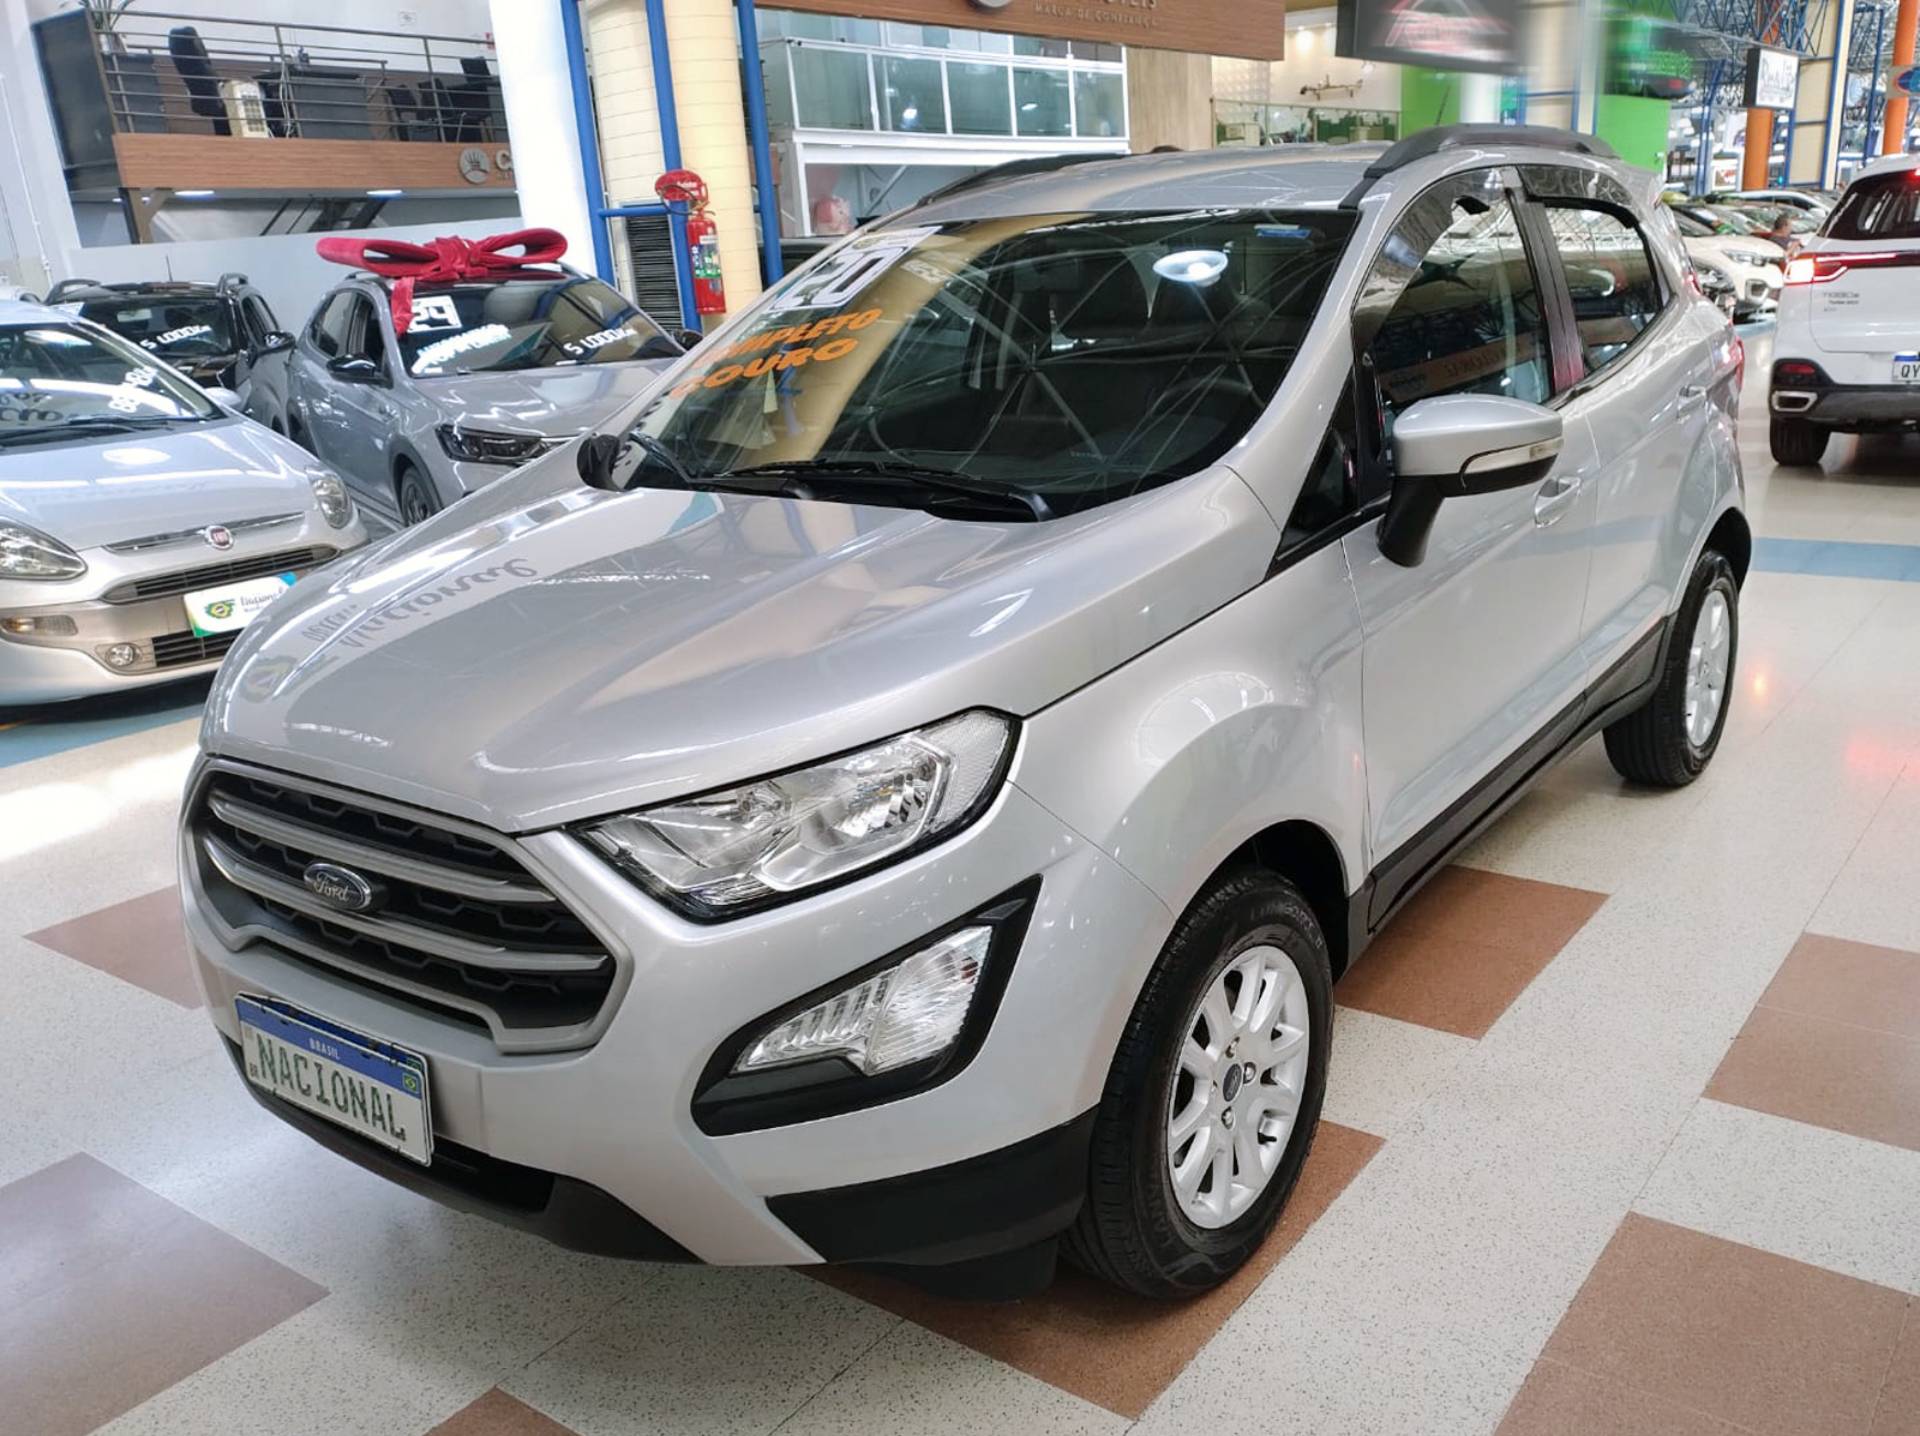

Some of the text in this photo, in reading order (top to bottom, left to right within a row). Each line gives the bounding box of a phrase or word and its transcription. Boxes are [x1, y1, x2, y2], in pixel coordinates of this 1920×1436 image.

[312, 870, 351, 903] Ford
[309, 1037, 341, 1060] BRASIL
[256, 1033, 407, 1143] NACIONAL
